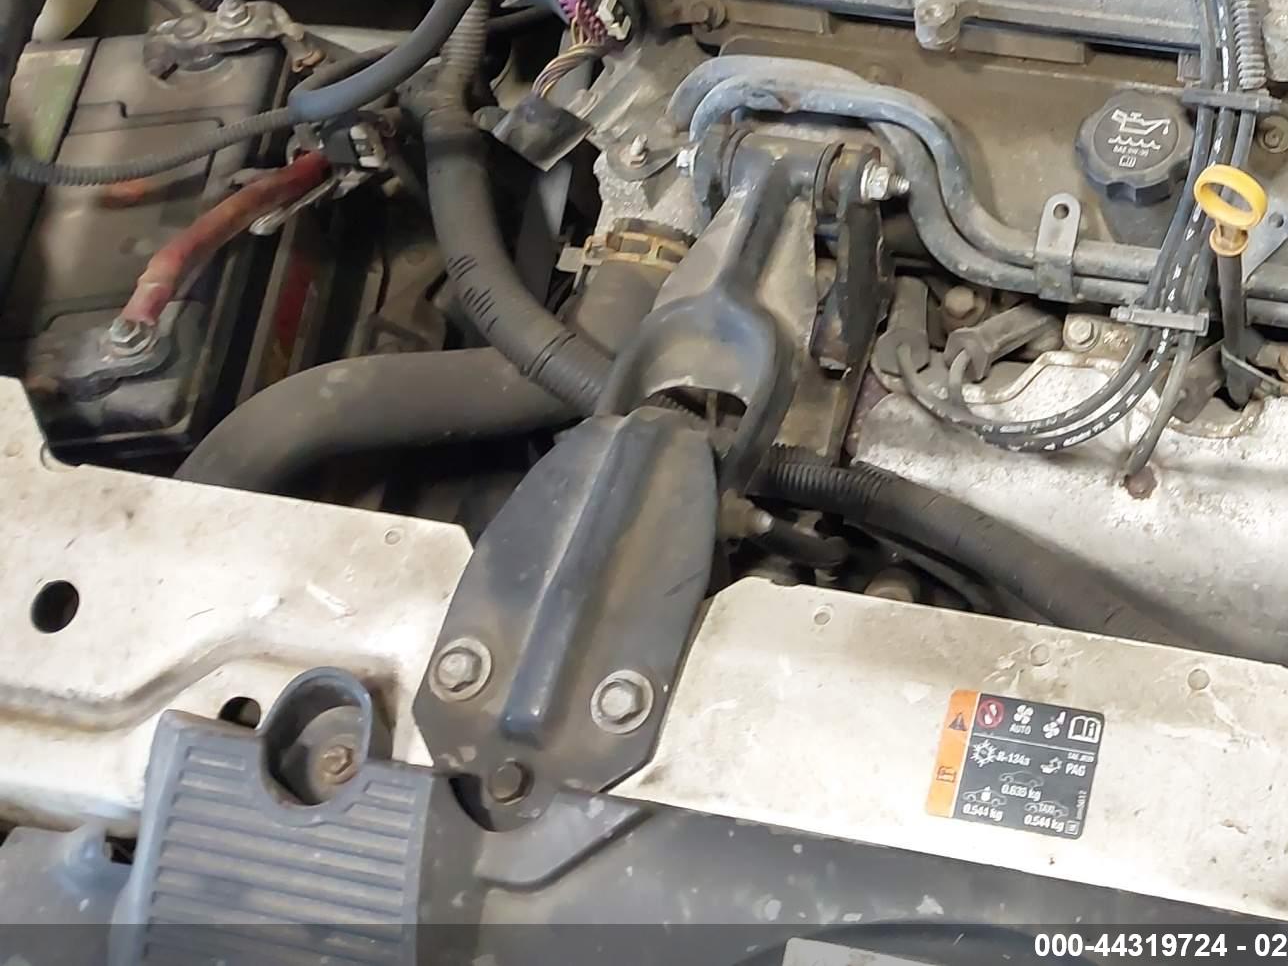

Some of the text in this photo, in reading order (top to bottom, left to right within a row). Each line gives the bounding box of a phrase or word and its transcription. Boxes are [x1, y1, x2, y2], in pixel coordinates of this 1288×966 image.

[1009, 724, 1032, 735] AUTO
[1065, 763, 1087, 777] PAG
[1028, 788, 1042, 802] kg
[989, 806, 1004, 822] kg
[1050, 817, 1065, 833] kg
